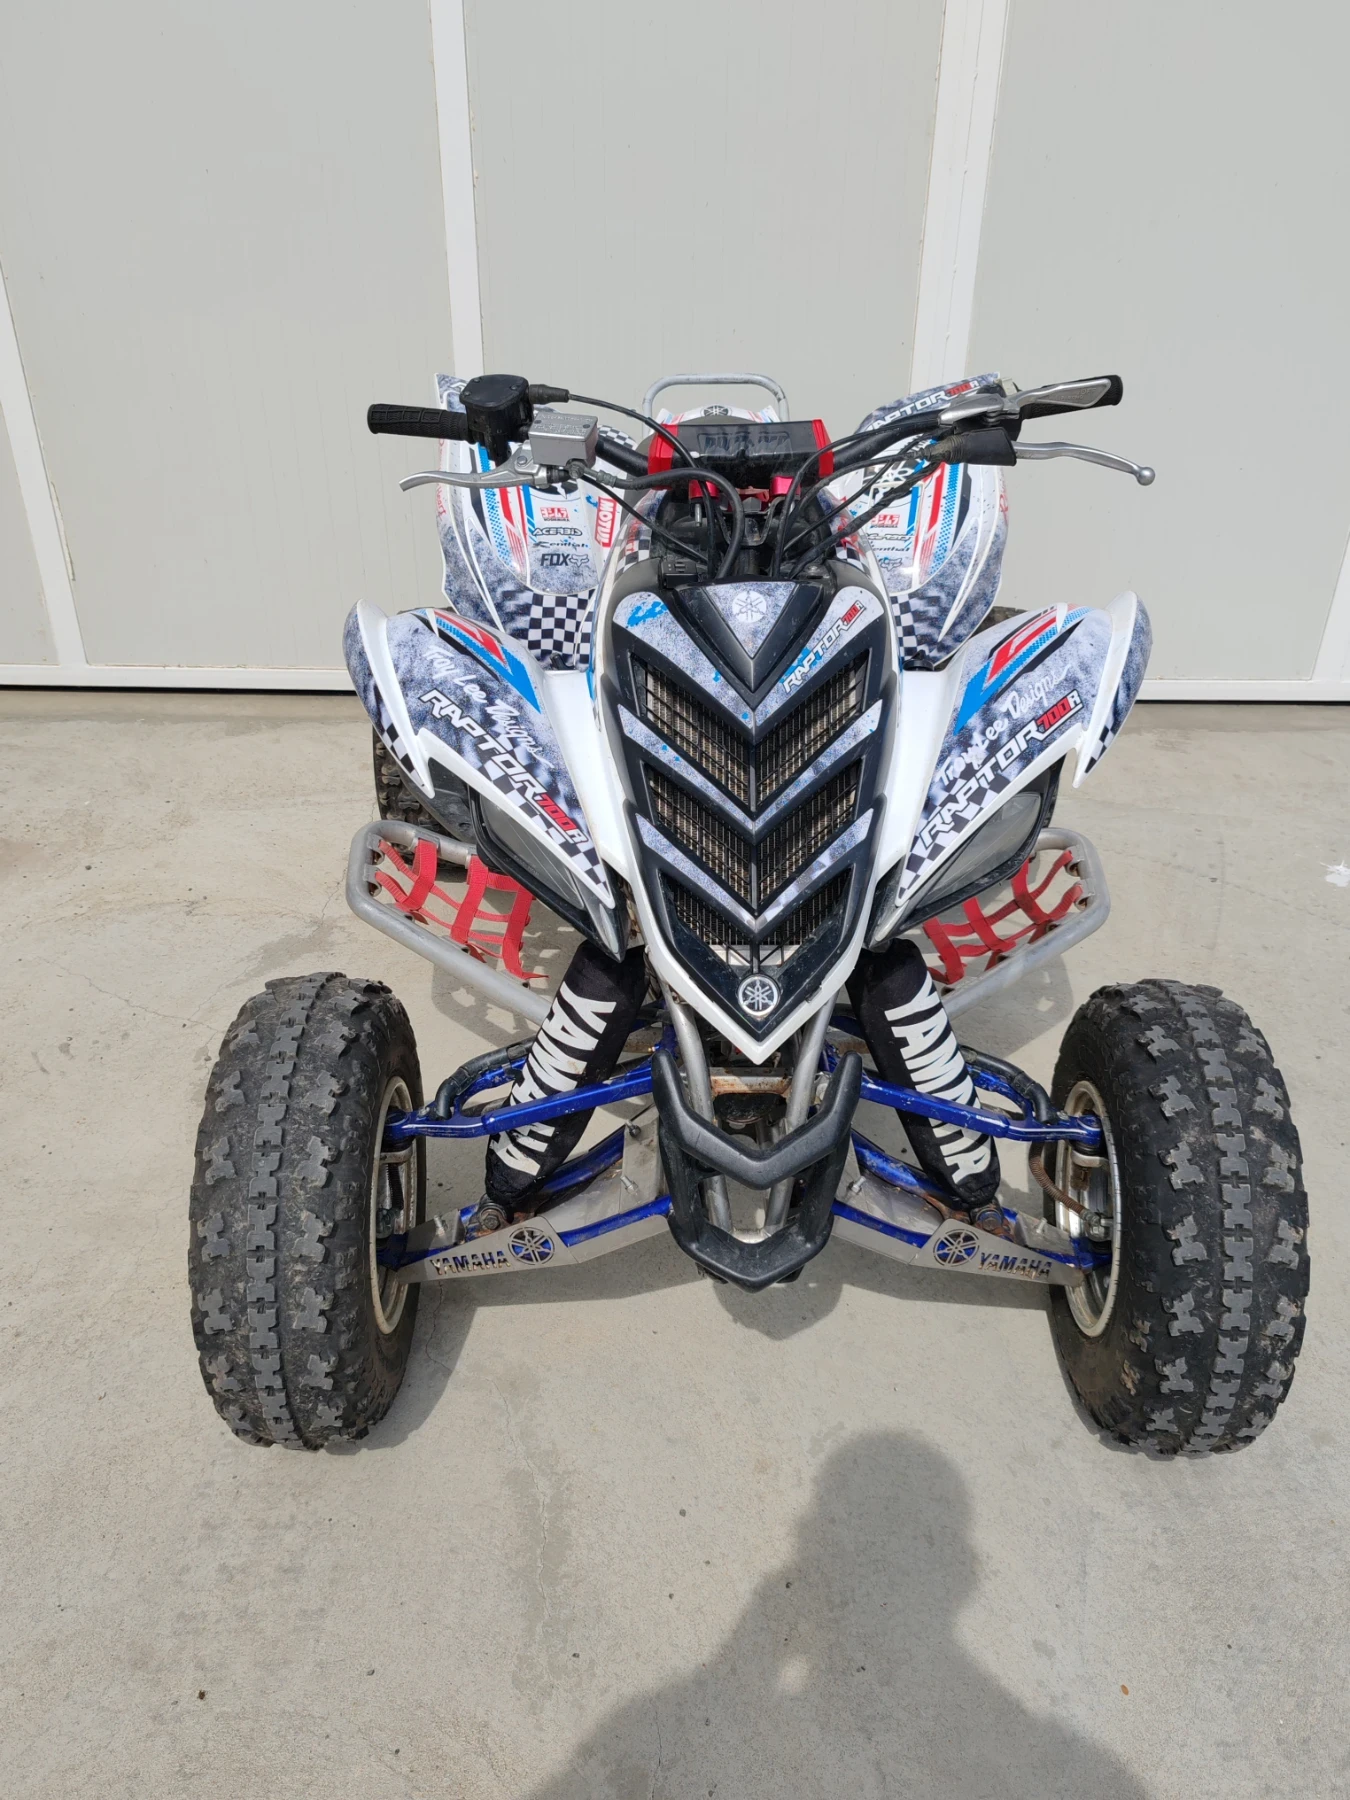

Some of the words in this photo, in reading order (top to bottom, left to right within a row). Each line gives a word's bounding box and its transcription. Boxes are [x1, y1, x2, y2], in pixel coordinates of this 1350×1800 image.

[864, 391, 950, 432] APTOR
[532, 527, 583, 536] ACERBIS
[596, 499, 615, 544] MOTUL
[540, 553, 570, 566] FOX
[453, 674, 488, 704] Lee
[1000, 664, 1073, 720] Designs
[489, 980, 617, 1176] YAMAHA
[884, 970, 992, 1185] YAMAHA
[429, 1250, 511, 1276] YAMAHA
[978, 1251, 1053, 1279] YAMAHA
